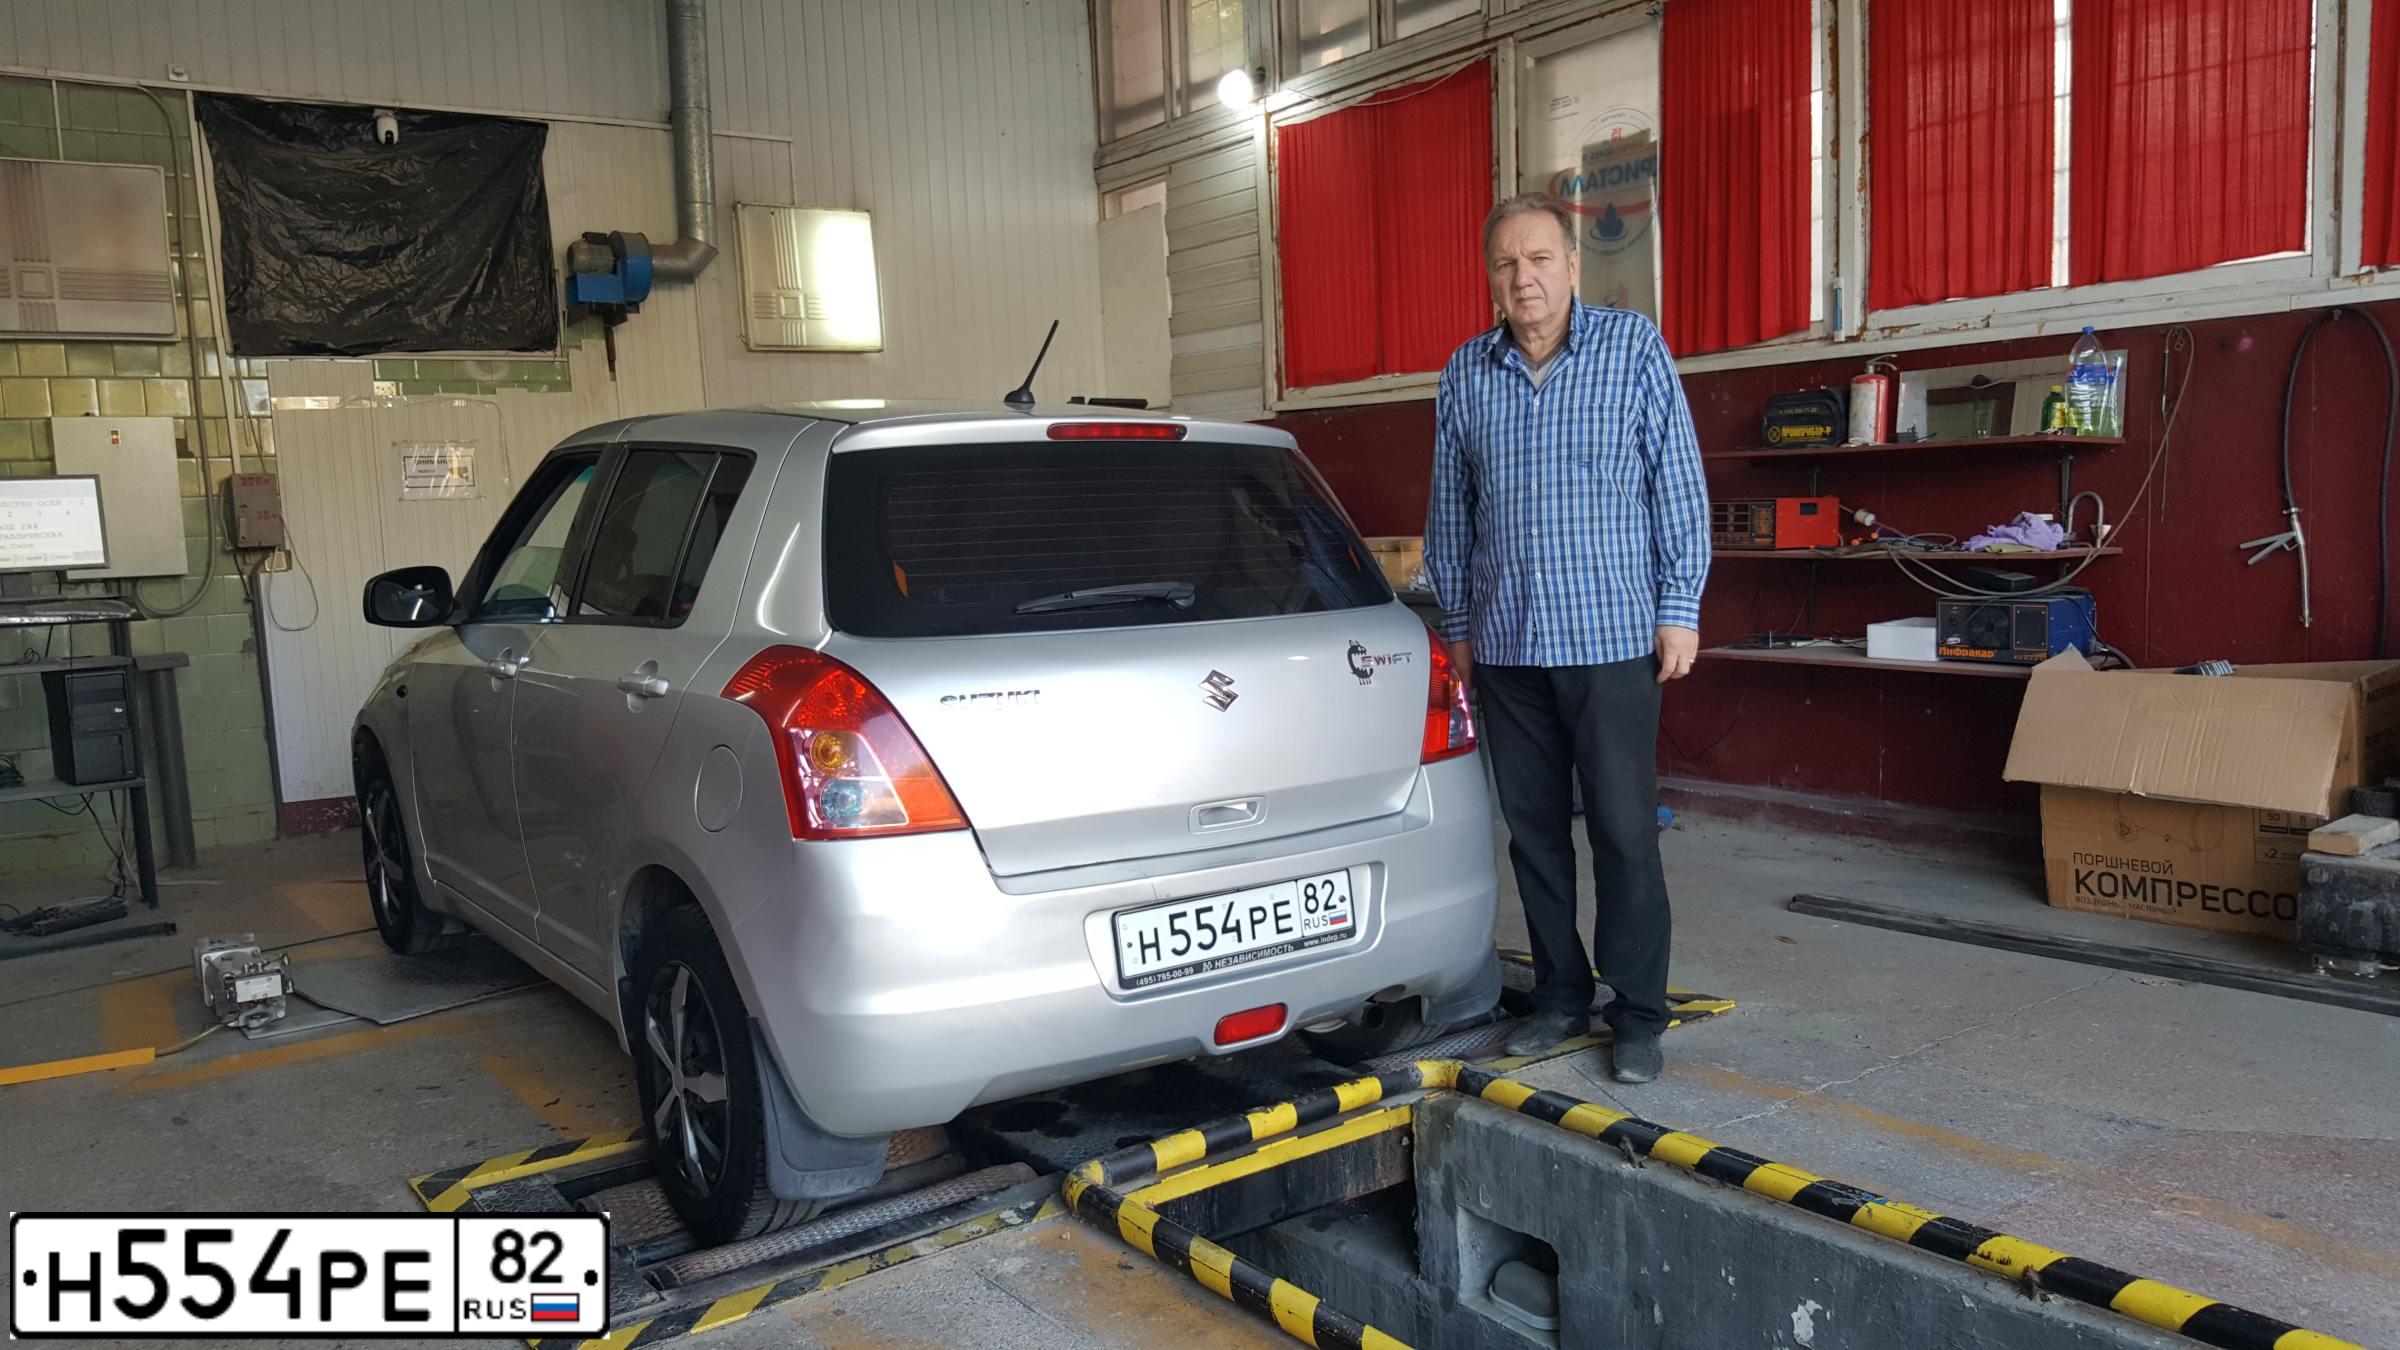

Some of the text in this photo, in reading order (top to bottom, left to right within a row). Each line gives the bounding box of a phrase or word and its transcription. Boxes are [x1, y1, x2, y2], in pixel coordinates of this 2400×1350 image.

[1361, 652, 1413, 668] SWIFT
[940, 689, 1040, 712] SUZUKI
[2073, 851, 2174, 875] ПОРШНЕВОЙ
[1303, 879, 1337, 914] 82
[2074, 868, 2297, 921] КОМПРЕССО
[1303, 914, 1329, 930] RUS
[1214, 944, 1294, 969] НЕЗАВИСИМОСТЬ
